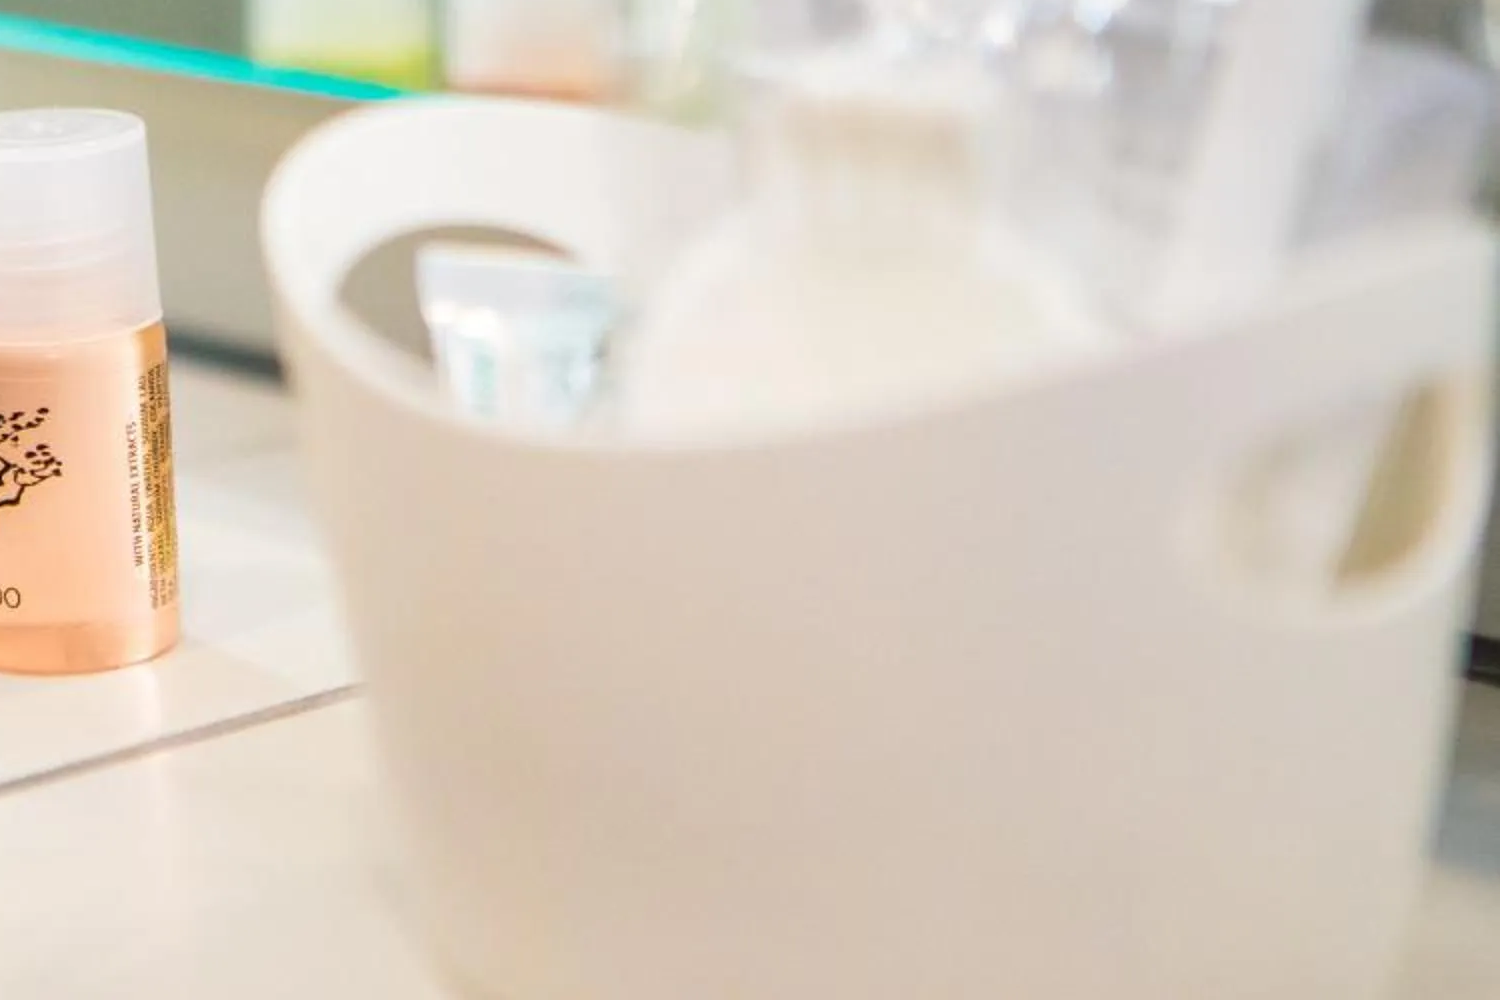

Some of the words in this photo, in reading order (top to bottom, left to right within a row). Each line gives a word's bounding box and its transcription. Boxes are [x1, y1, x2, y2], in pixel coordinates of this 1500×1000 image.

[126, 421, 139, 479] EXTRACTS
[131, 482, 142, 534] NATURAL
[134, 536, 145, 566] WITH
